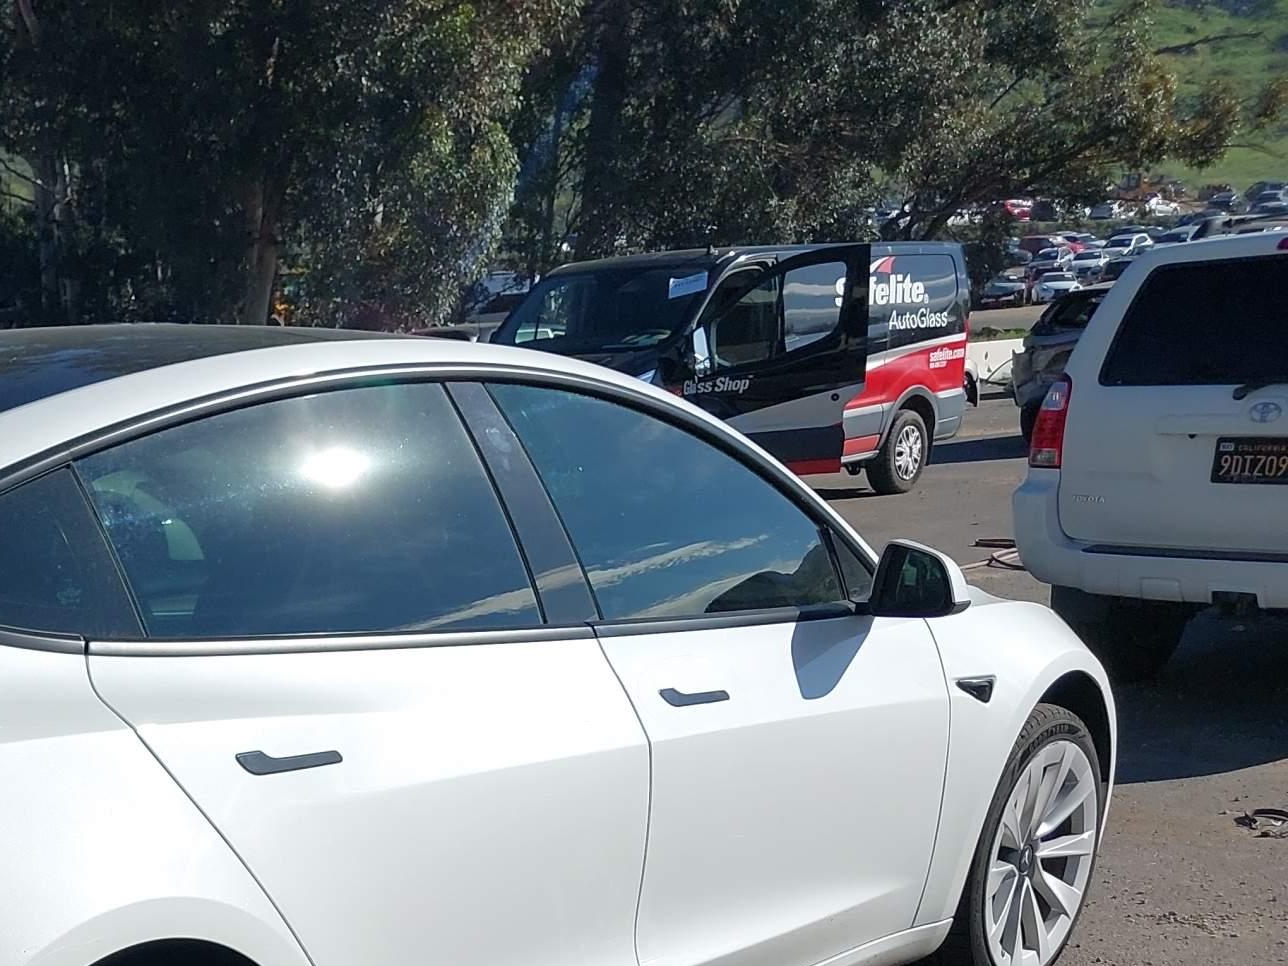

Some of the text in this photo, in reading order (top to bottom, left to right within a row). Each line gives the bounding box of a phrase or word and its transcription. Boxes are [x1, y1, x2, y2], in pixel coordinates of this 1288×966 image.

[834, 272, 925, 307] Sfelite
[889, 308, 948, 330] AutoGlass
[683, 379, 713, 395] Glss
[714, 376, 749, 394] Shop
